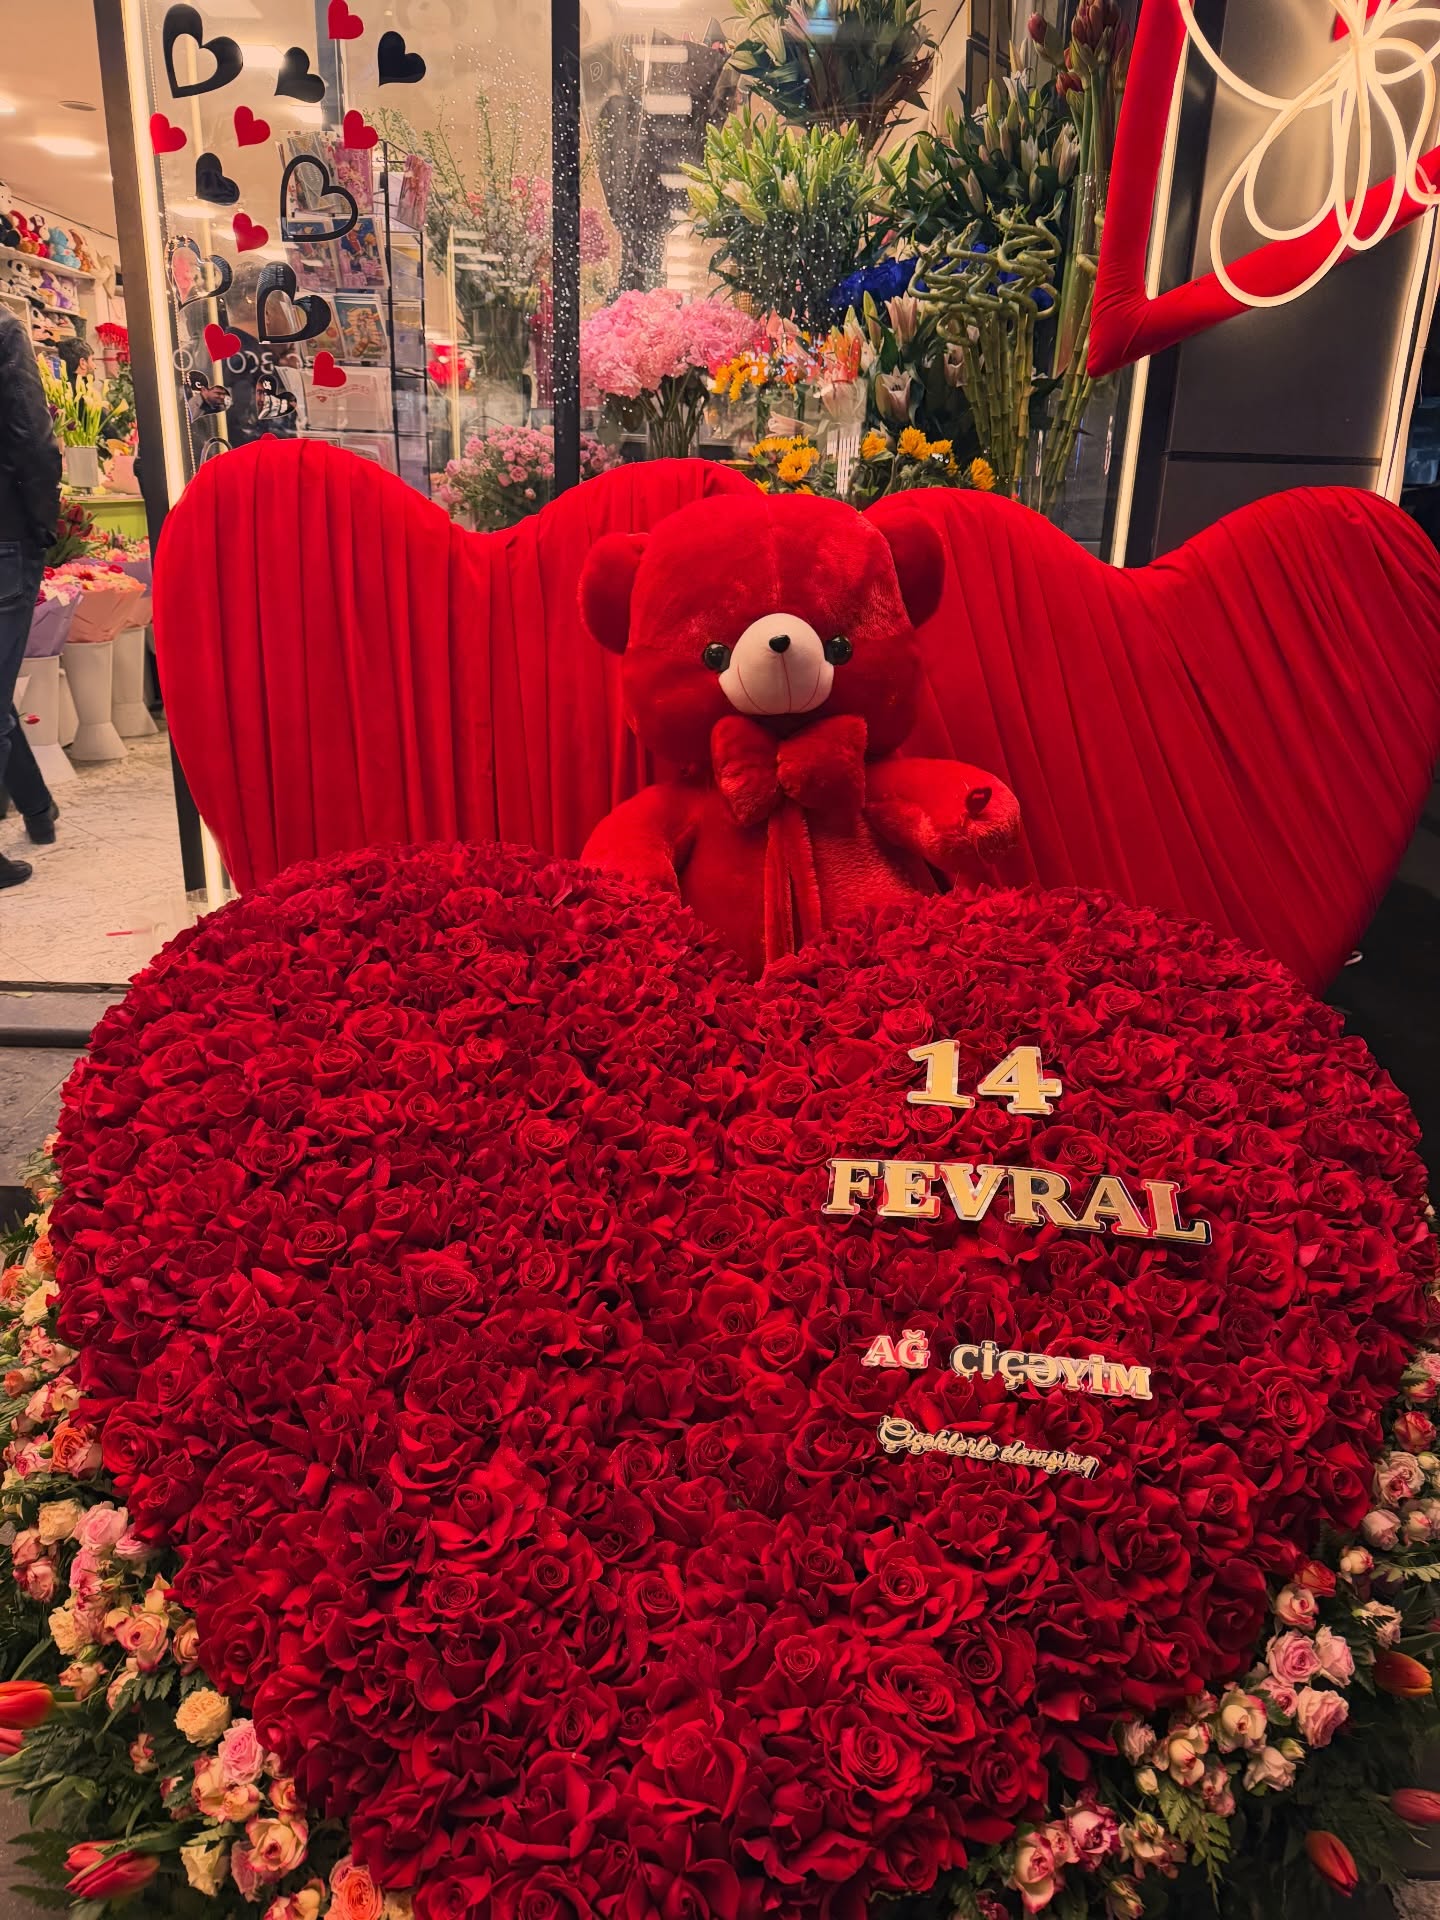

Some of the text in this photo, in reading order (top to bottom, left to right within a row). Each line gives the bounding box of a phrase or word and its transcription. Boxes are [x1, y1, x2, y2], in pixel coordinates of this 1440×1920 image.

[907, 1039, 1063, 1115] 14
[821, 1158, 1212, 1245] FEVRAL
[861, 1329, 1153, 1400] AĞ ÇİÇƏYİM
